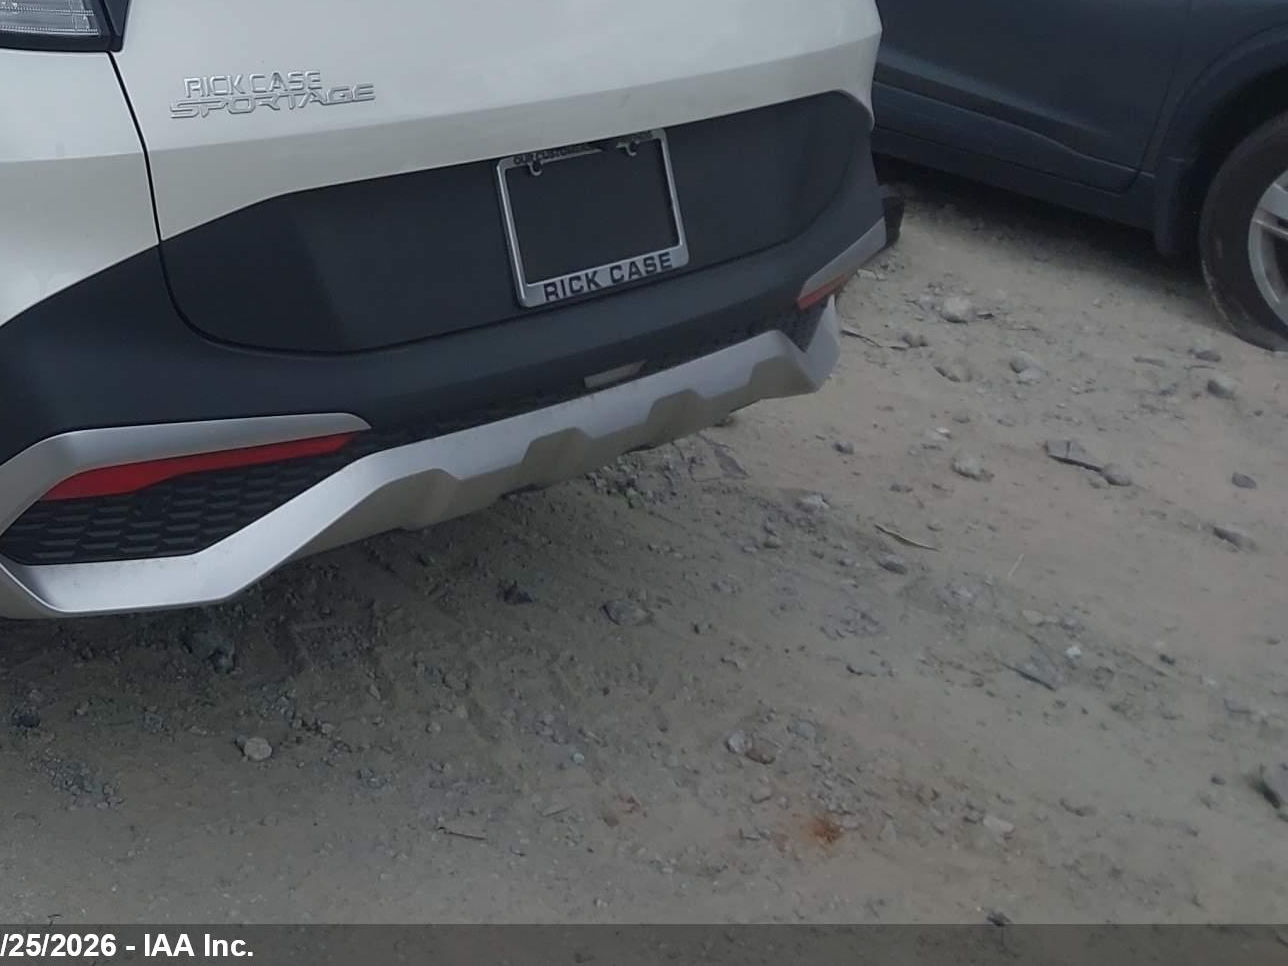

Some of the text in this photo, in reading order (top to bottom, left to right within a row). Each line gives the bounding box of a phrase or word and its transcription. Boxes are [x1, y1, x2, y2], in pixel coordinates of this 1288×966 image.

[170, 83, 377, 119] SPORTAGE
[184, 70, 323, 99] RICK CASE
[543, 251, 673, 302] RICK CASE
